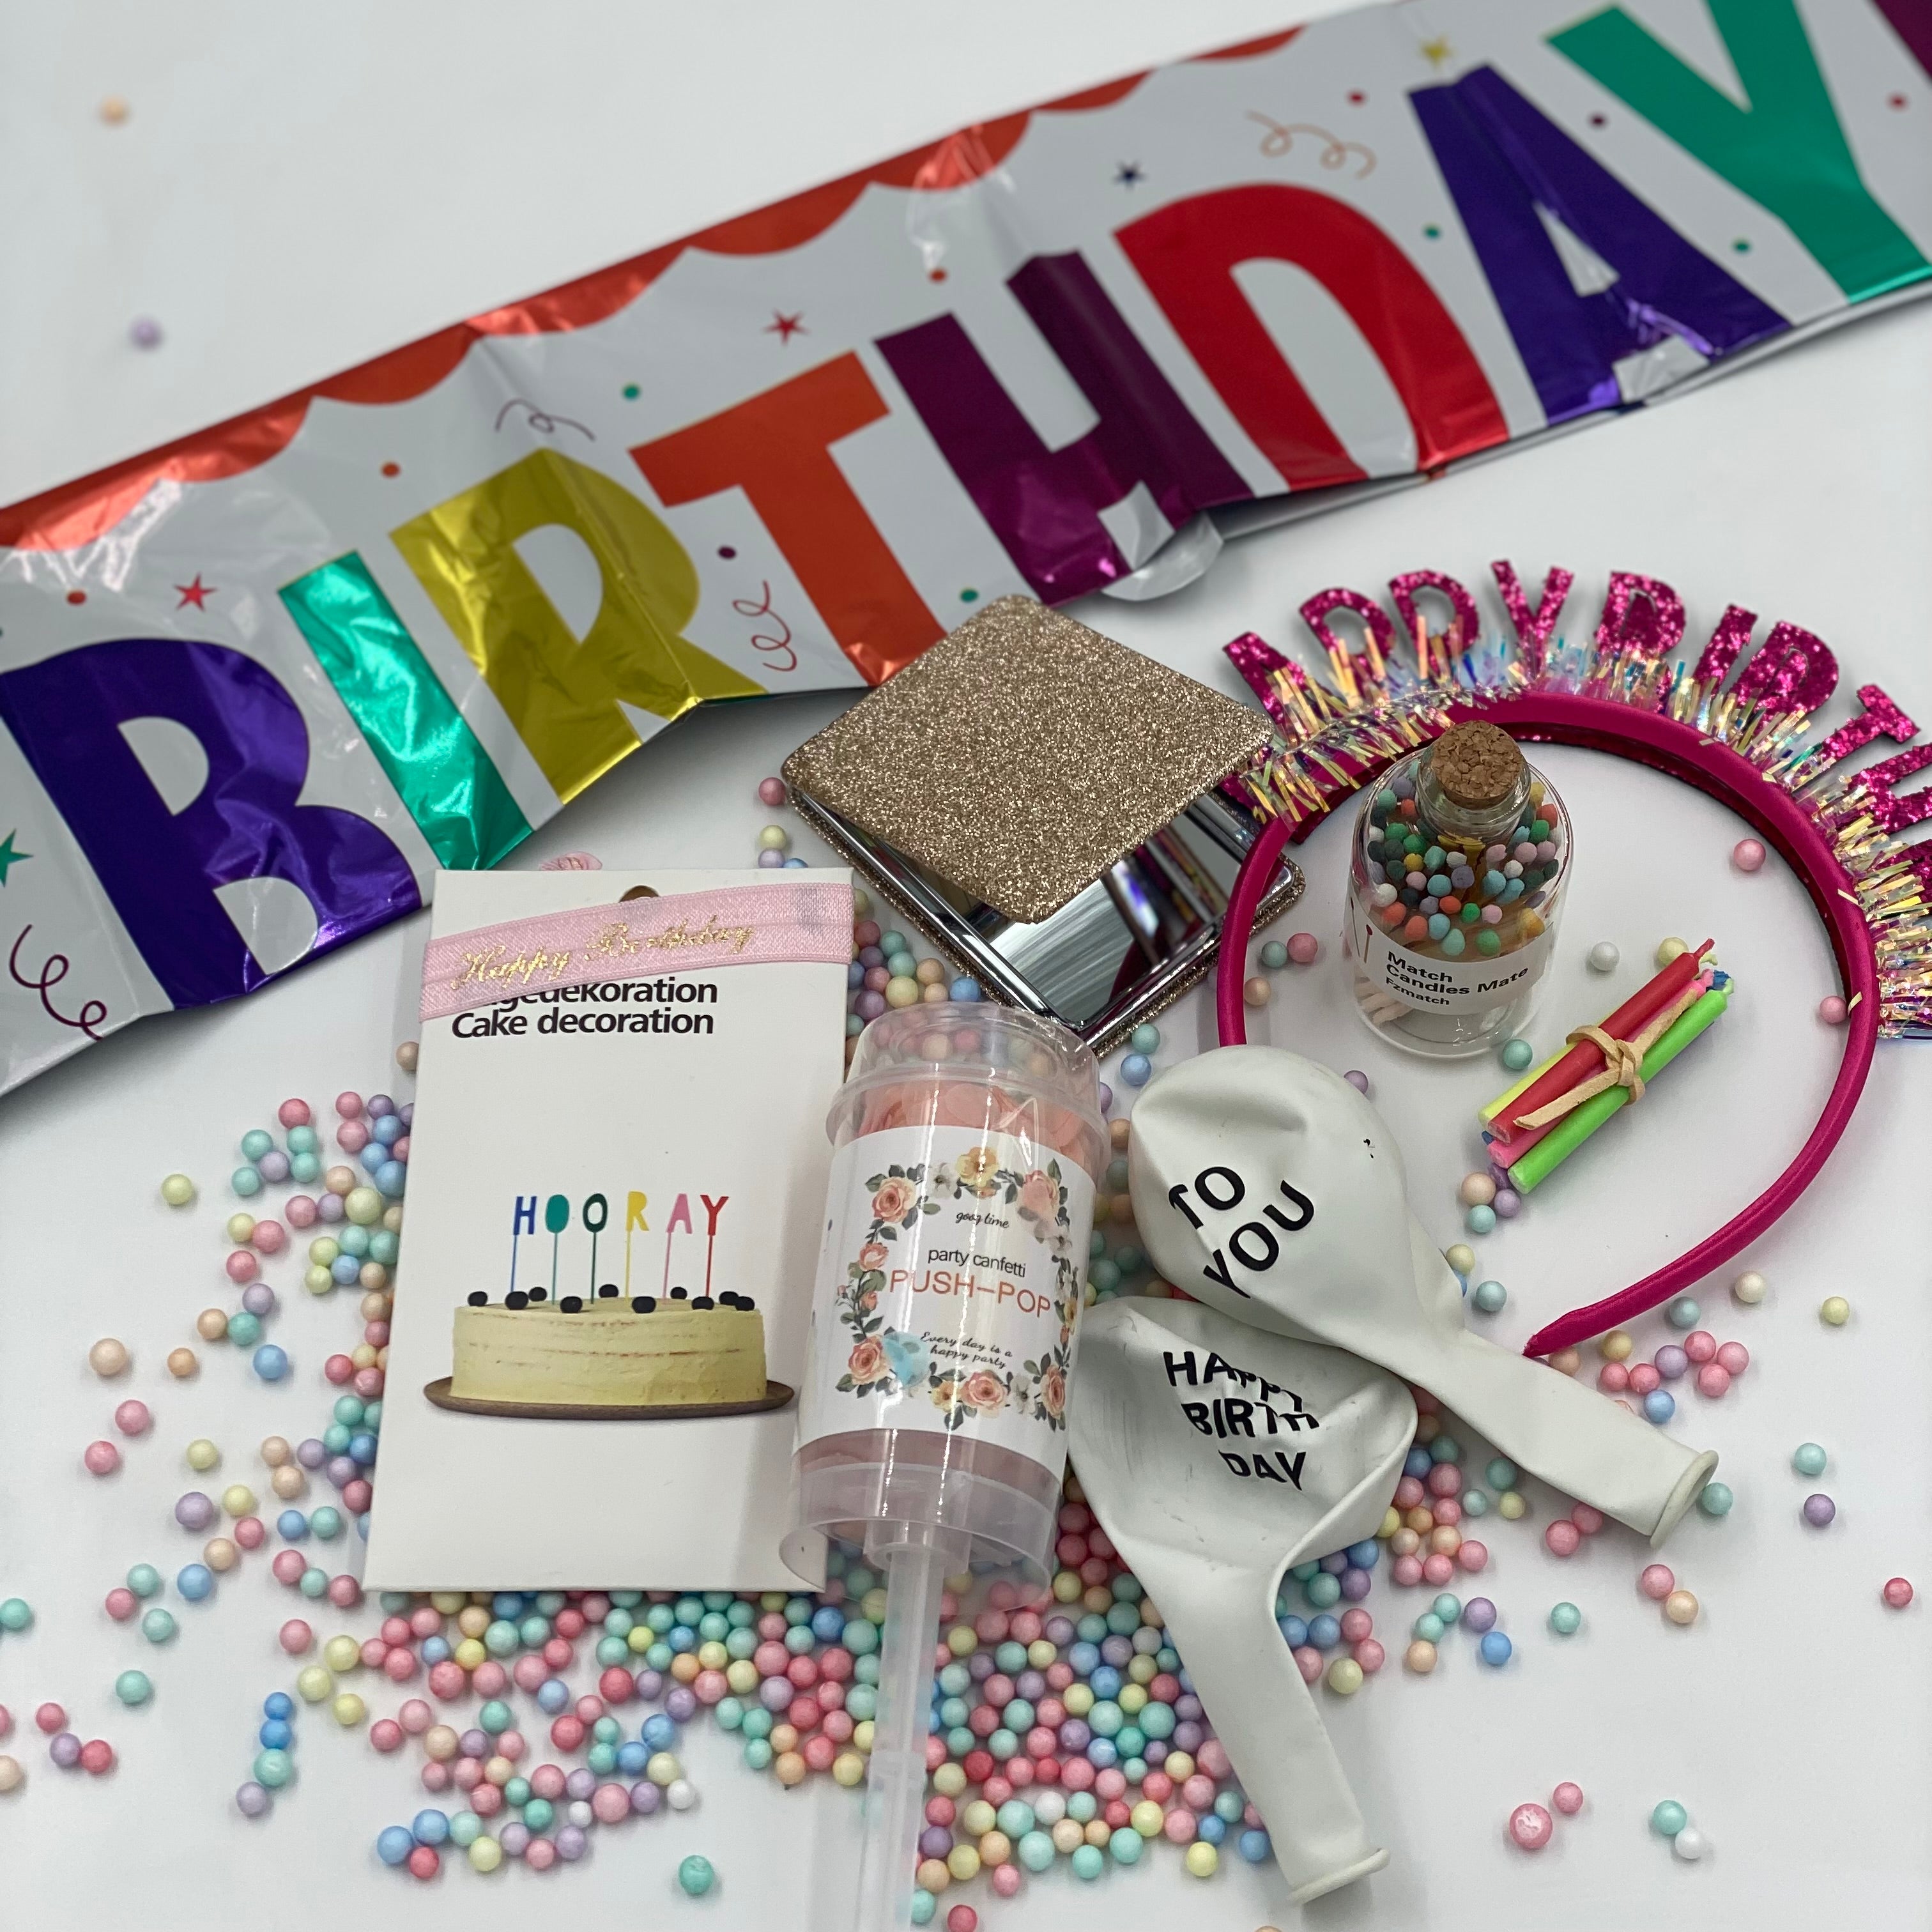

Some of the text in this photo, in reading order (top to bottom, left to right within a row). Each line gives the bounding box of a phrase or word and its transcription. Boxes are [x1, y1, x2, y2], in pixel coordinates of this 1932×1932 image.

[0, 0, 1932, 1011] BIRTHDAY
[1222, 558, 1932, 907] APPY BIRTH
[450, 944, 572, 990] Happy
[1386, 963, 1529, 995] Candles Mate
[1388, 951, 1453, 983] Match
[1386, 977, 1450, 1005] Fzmatch
[452, 1006, 714, 1039] Cake decoration
[512, 1190, 730, 1237] HOORAY
[1169, 1167, 1246, 1230] TO
[1202, 1179, 1315, 1299] YOU
[927, 1249, 1026, 1278] party canfetti
[920, 1331, 958, 1347] Every
[962, 1337, 986, 1352] day
[990, 1344, 1001, 1354] is
[930, 1344, 1006, 1369] happy party
[1218, 1449, 1307, 1491] DAY
